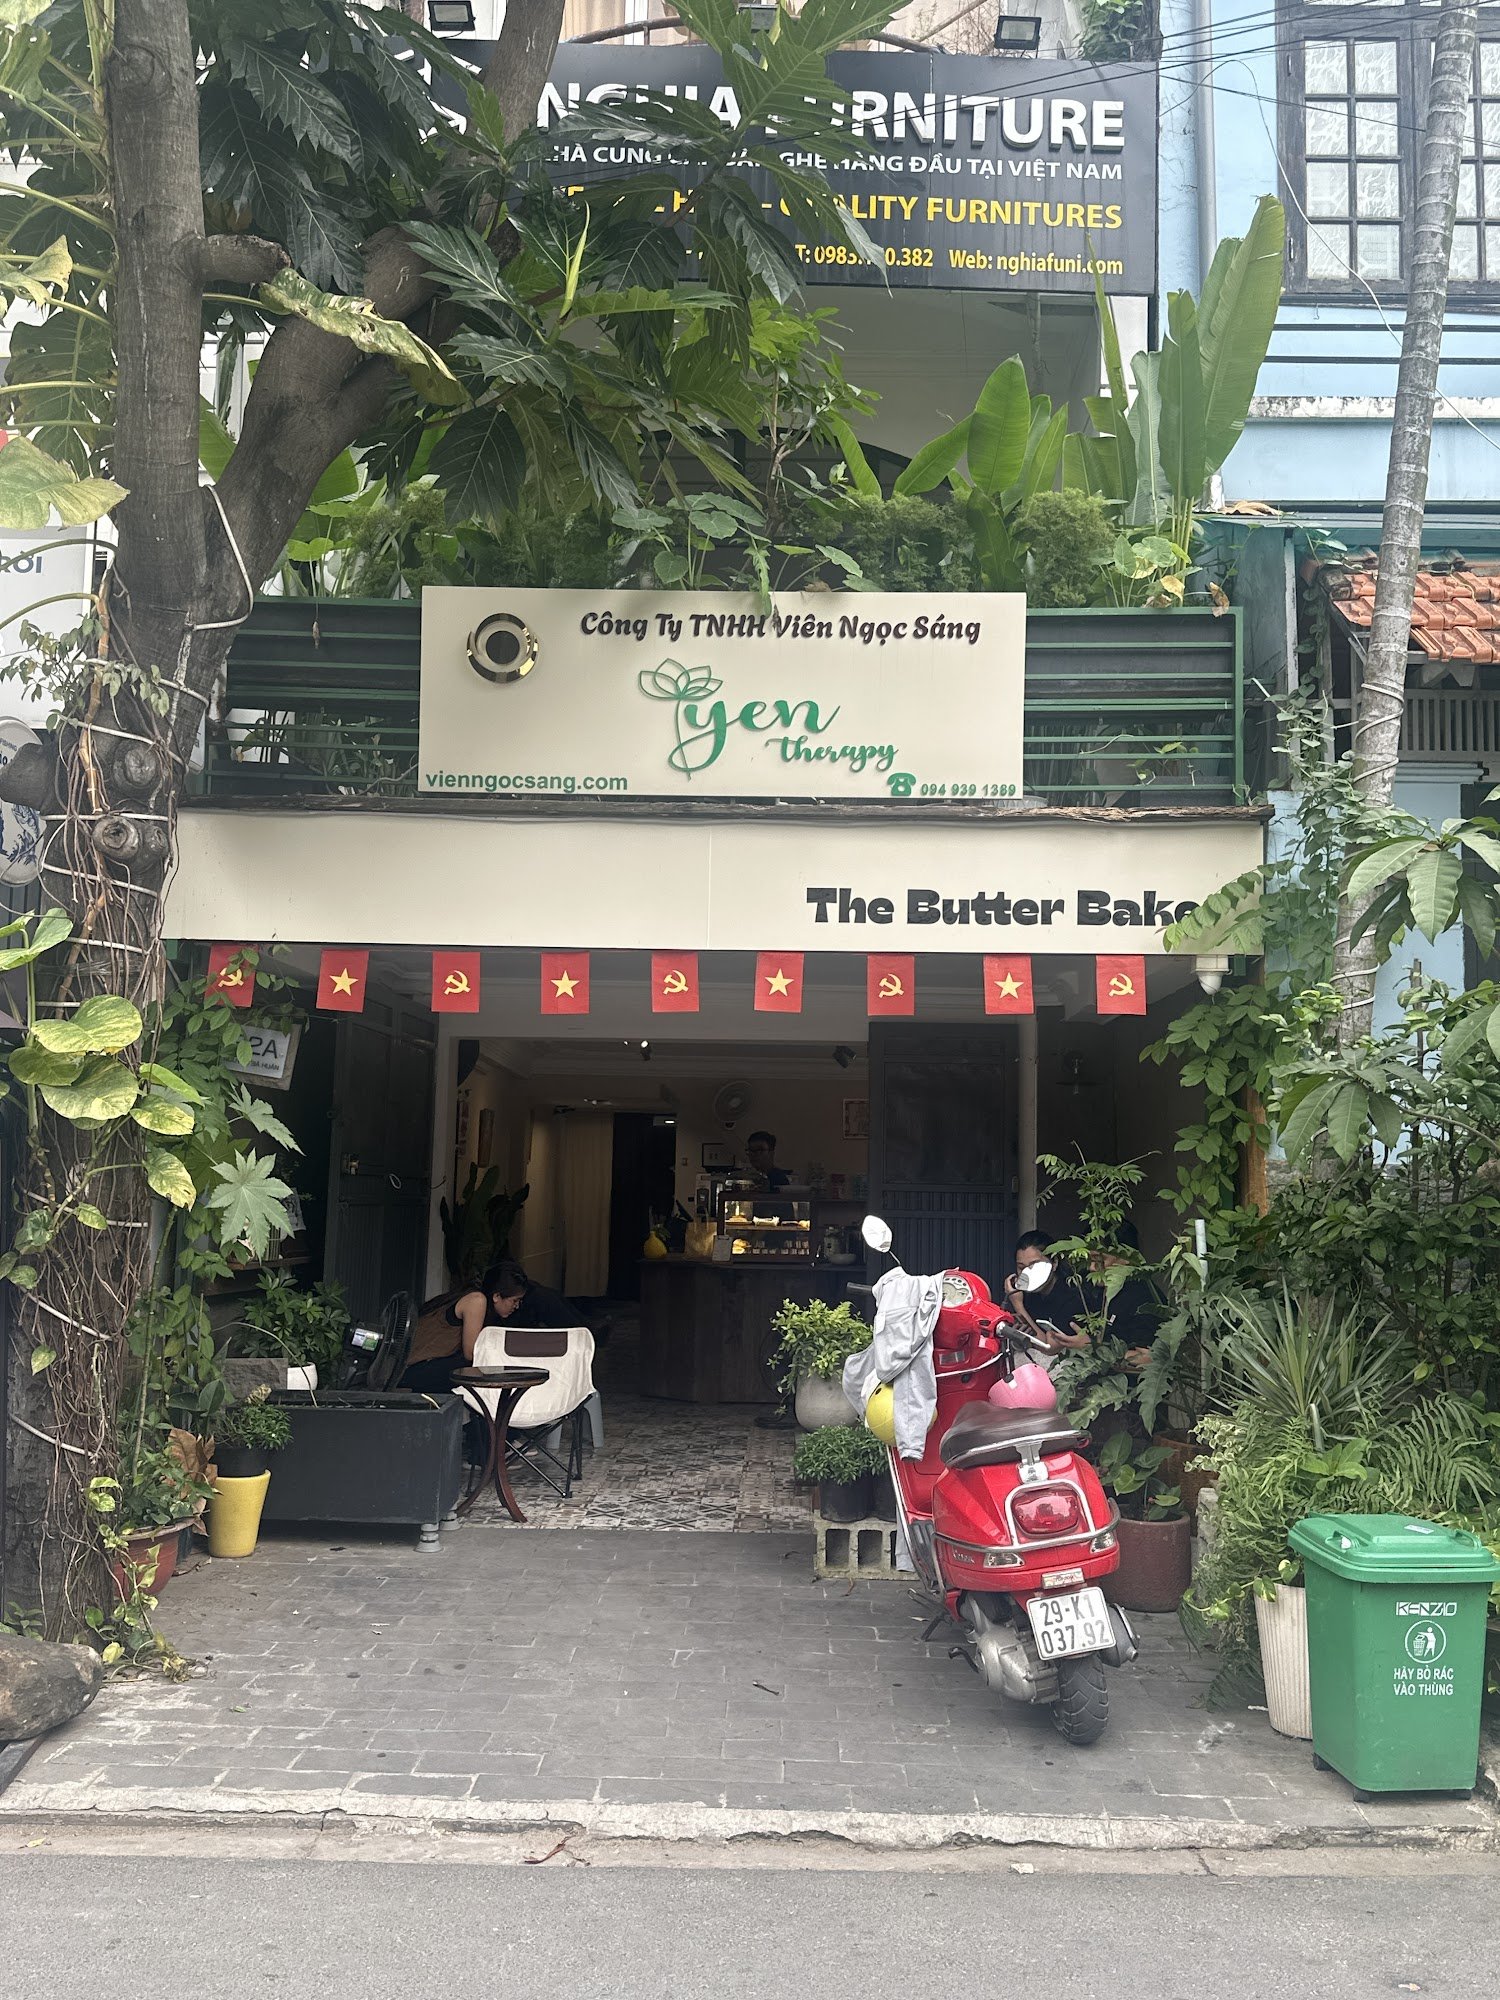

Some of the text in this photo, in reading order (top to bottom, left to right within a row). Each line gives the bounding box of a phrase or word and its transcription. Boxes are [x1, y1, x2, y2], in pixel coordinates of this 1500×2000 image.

[765, 90, 1126, 149] RNITURE
[909, 152, 962, 175] ĐẦU
[966, 158, 1003, 180] TẠI
[1007, 158, 1061, 182] VIỆT
[1066, 162, 1123, 180] NAM
[779, 194, 1123, 229] LITY FURNITURES
[949, 248, 993, 269] Web:
[996, 251, 1123, 276] nghiafuni.com
[580, 610, 982, 646] Công Ty TNHH Viên Ngọc Sáng
[764, 735, 899, 774] therapy
[426, 770, 629, 793] vienngocsang.com
[920, 783, 1017, 797] 094 939 1389
[806, 886, 895, 924] The
[906, 888, 1065, 926] Butter
[1039, 1593, 1096, 1627] 29-K1
[1040, 1619, 1110, 1655] 037.92
[1393, 1681, 1454, 1696] VÀO THÙNG
[1433, 1665, 1454, 1681] RÁC
